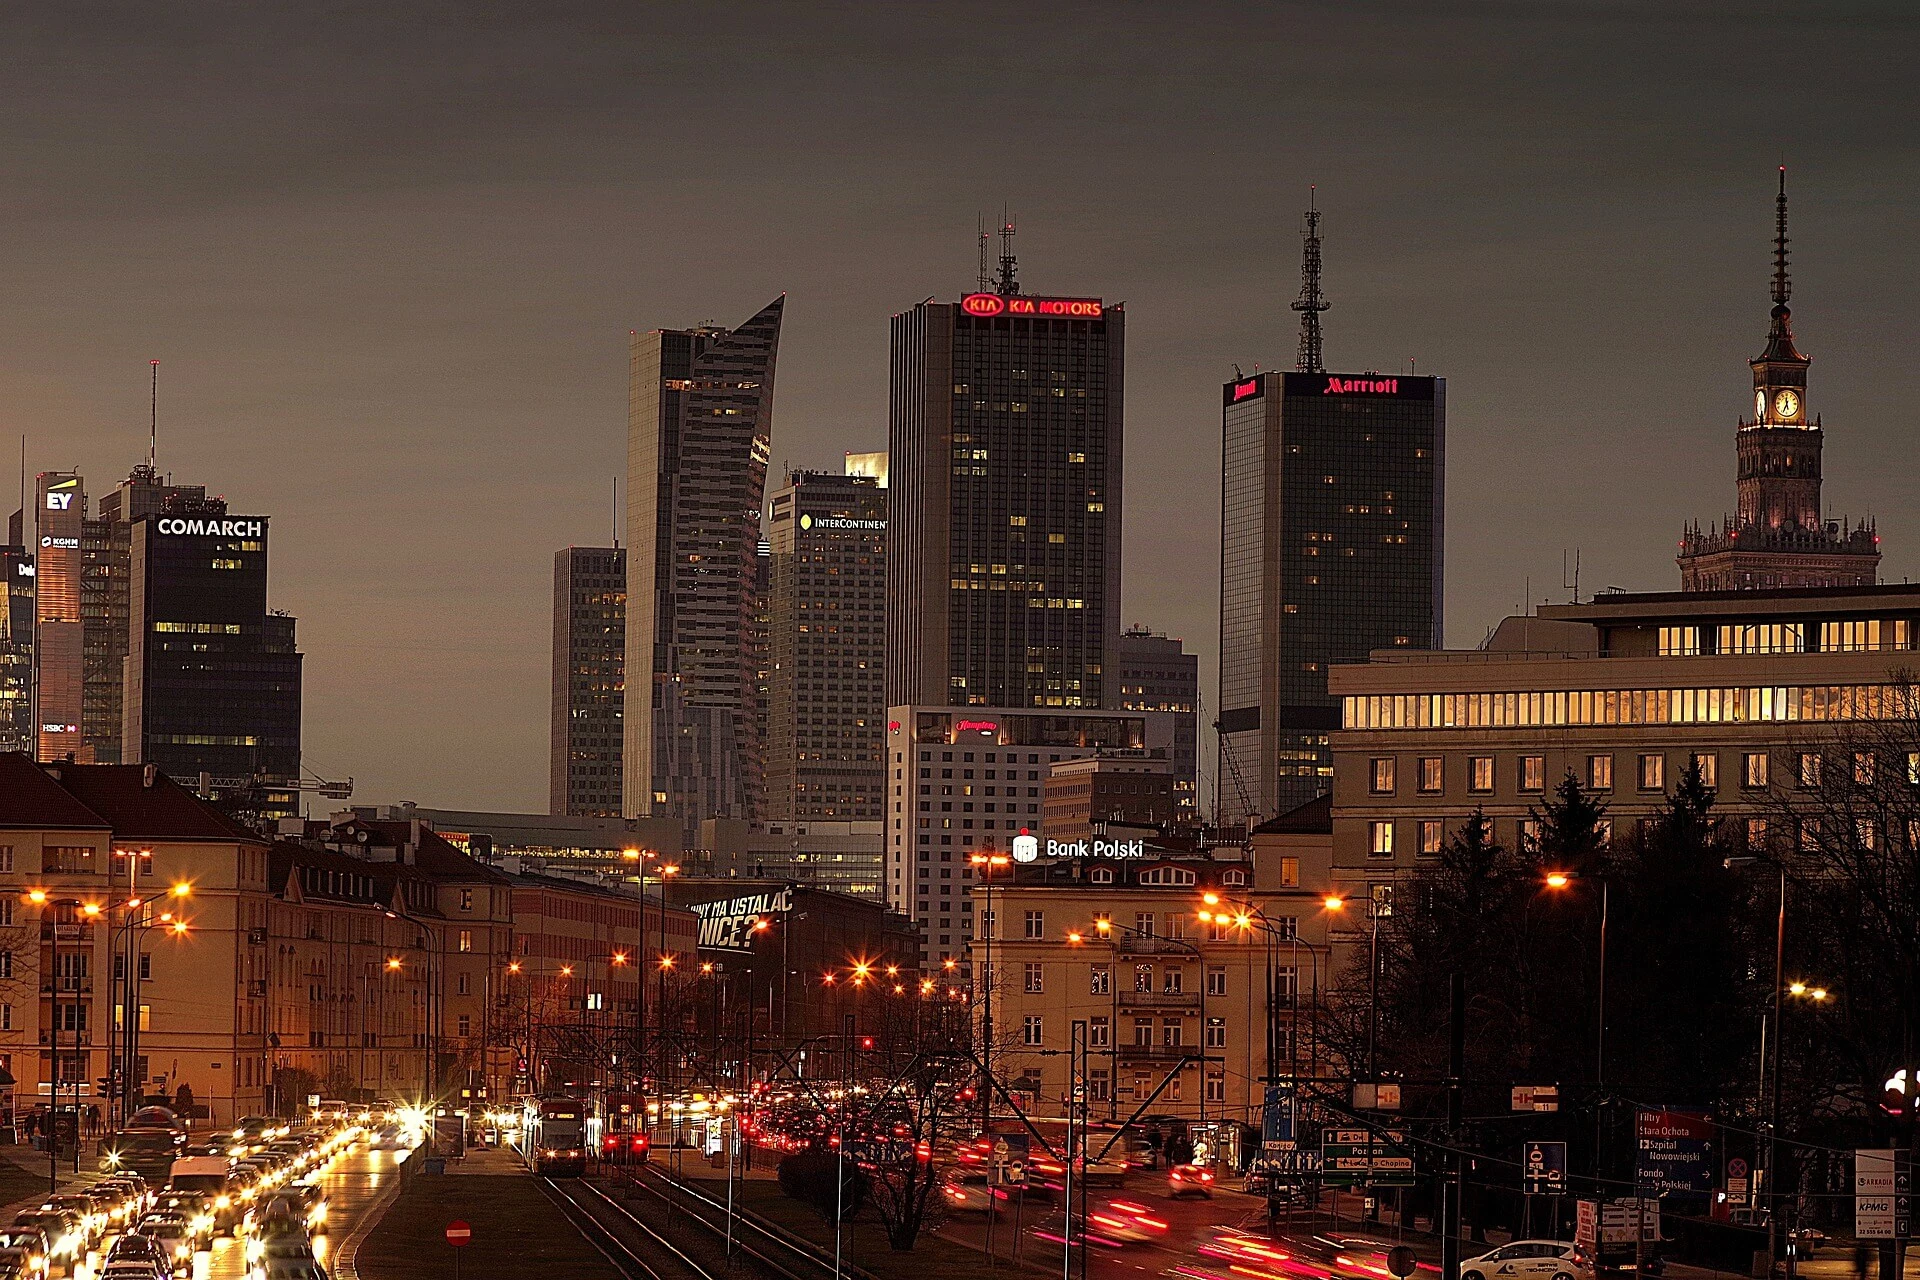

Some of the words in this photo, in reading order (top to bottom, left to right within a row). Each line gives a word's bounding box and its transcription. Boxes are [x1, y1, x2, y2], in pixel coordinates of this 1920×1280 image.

[969, 299, 996, 312] KIA
[1008, 300, 1034, 314] KIA
[1039, 301, 1101, 316] MOTORS
[1323, 377, 1398, 394] Marriott
[46, 492, 73, 510] EY
[158, 519, 261, 537] COMARCH
[815, 517, 888, 530] INTERCONTINEN
[53, 538, 78, 546] KGHM
[42, 724, 64, 733] HSBC
[956, 719, 997, 732] Hampton
[1047, 839, 1089, 857] Bank
[1093, 839, 1144, 858] Polski
[711, 900, 728, 918] MA
[730, 886, 793, 916] USTALAĆ
[1661, 1126, 1690, 1137] Ochota
[1352, 1146, 1383, 1155] Pozań
[1650, 1140, 1677, 1151] Szpital
[1650, 1152, 1700, 1163] Nowowiejski
[1380, 1159, 1410, 1168] Chopina
[1661, 1180, 1691, 1191] Polskiej
[1866, 1178, 1893, 1186] ARKADIA
[1859, 1203, 1888, 1212] KPMG
